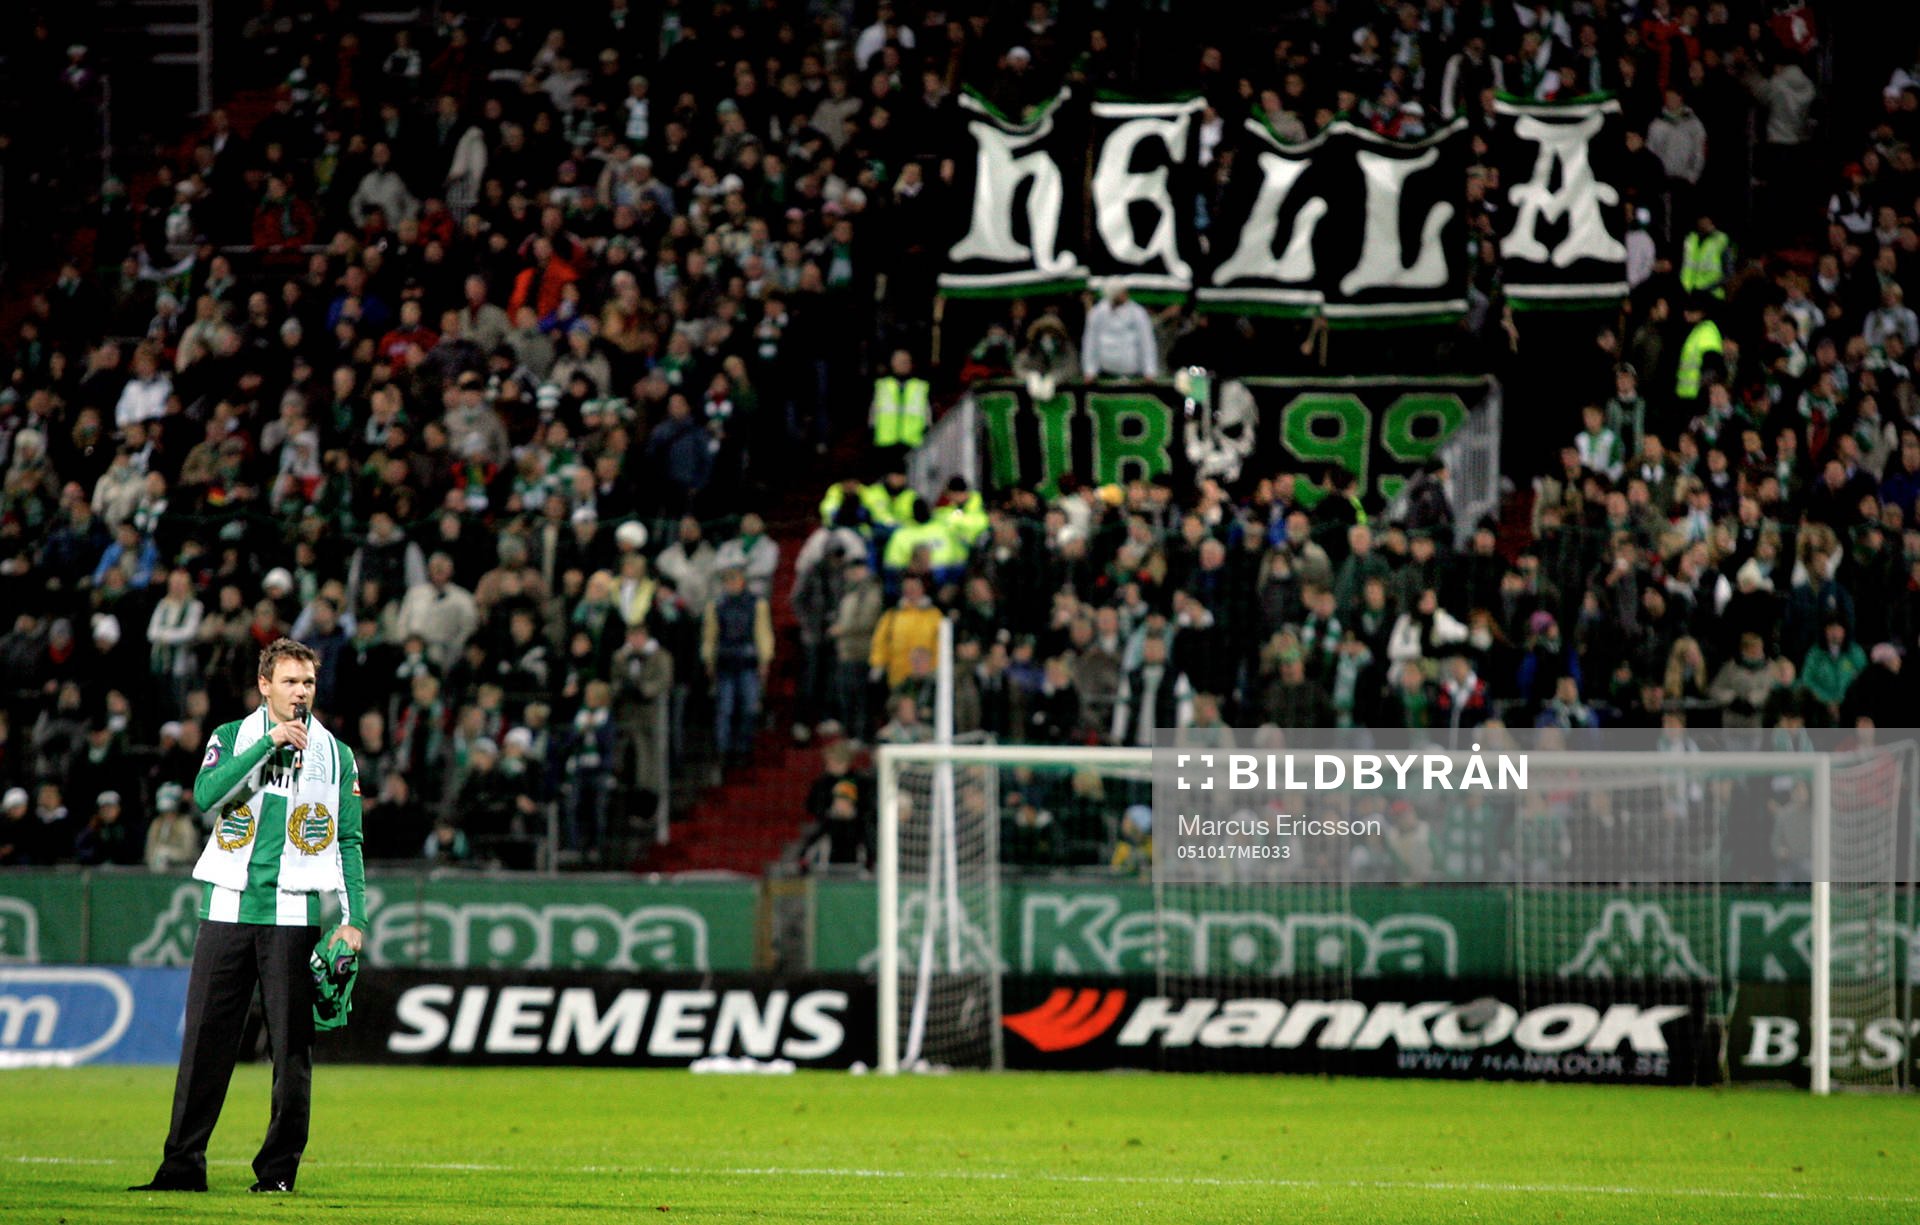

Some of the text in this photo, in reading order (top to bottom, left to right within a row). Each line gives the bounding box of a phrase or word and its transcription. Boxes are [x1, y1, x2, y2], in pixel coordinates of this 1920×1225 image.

[1022, 893, 1458, 977] Kappa
[387, 984, 848, 1060] SIEMENS
[1741, 1014, 1920, 1069] BES
